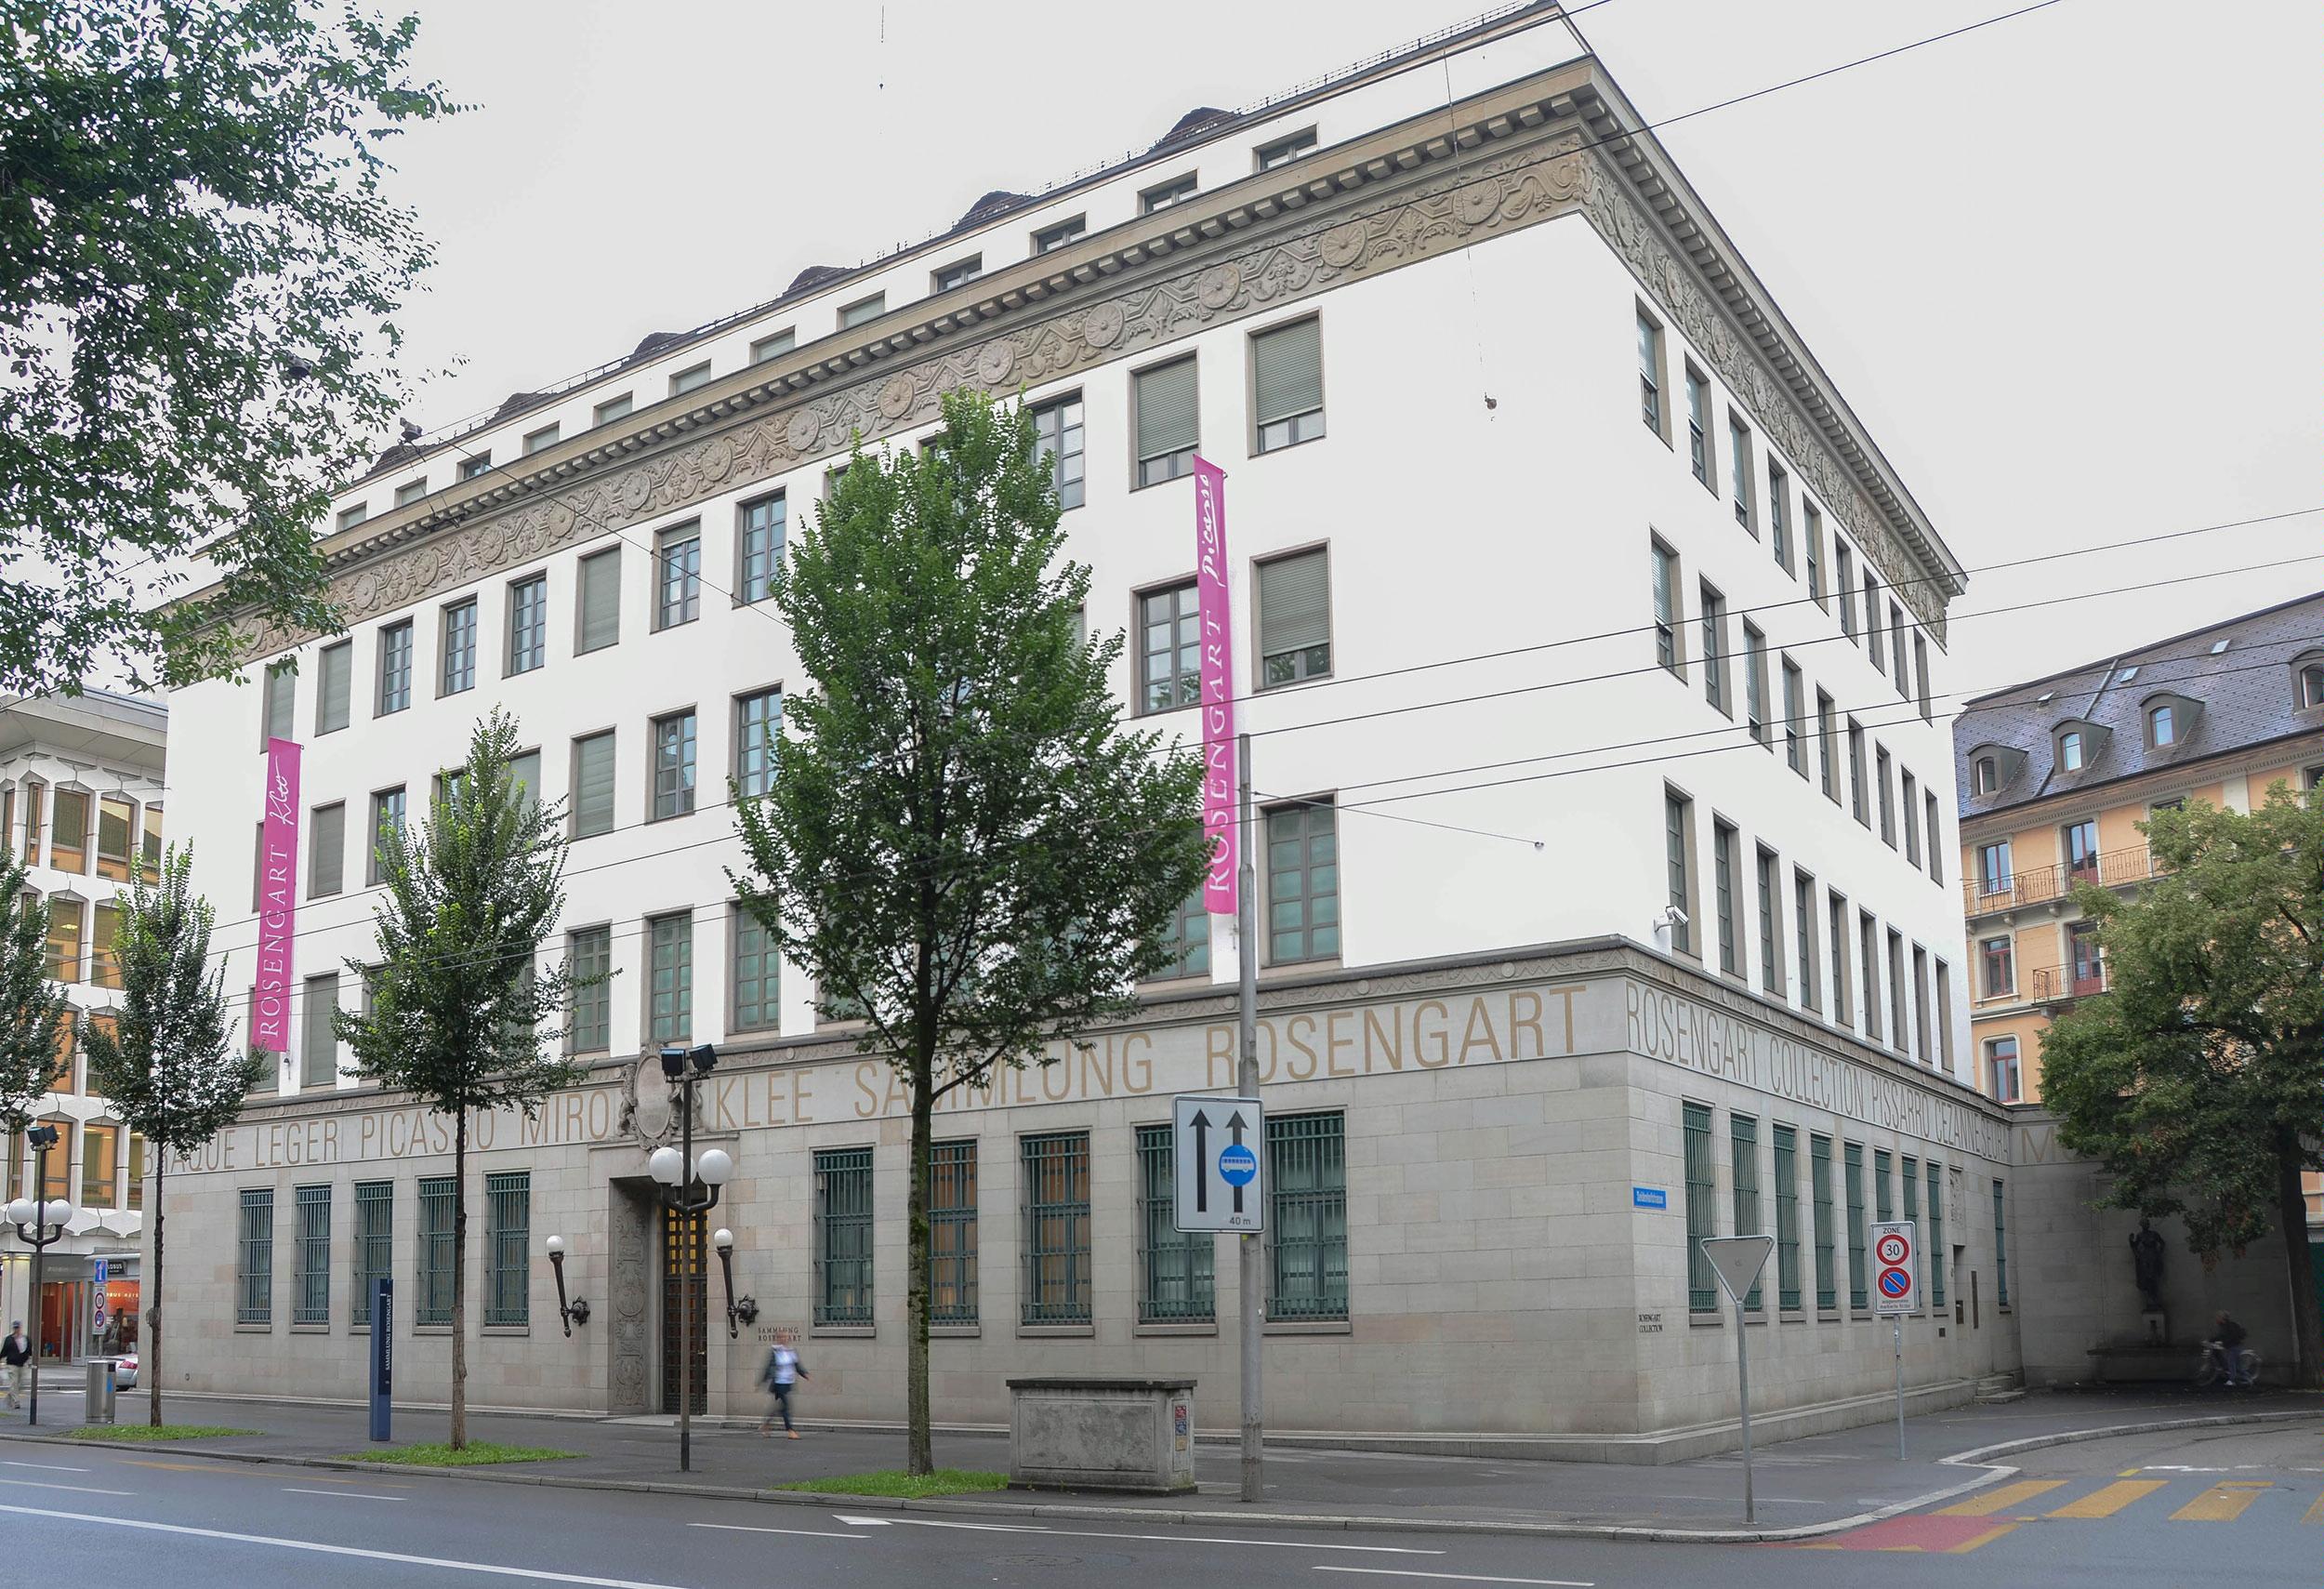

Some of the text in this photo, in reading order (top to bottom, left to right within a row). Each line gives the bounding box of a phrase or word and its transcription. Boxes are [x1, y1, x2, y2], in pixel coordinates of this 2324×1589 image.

[1207, 610, 1230, 894] ROSENGART
[259, 844, 287, 1038] ROSENGART
[255, 1119, 338, 1168] LEGER
[521, 1089, 610, 1145] MIRO
[716, 1068, 814, 1130] KLEE
[1208, 986, 1587, 1088] ROSENGART
[1625, 980, 1759, 1086] ROSENGART
[1770, 1035, 1864, 1119] COLLECTION
[1872, 1073, 1930, 1139] PISSARRO
[1934, 1098, 1980, 1153] CEZANNE
[1229, 1216, 1241, 1225] 40
[1886, 1244, 1900, 1256] 30
